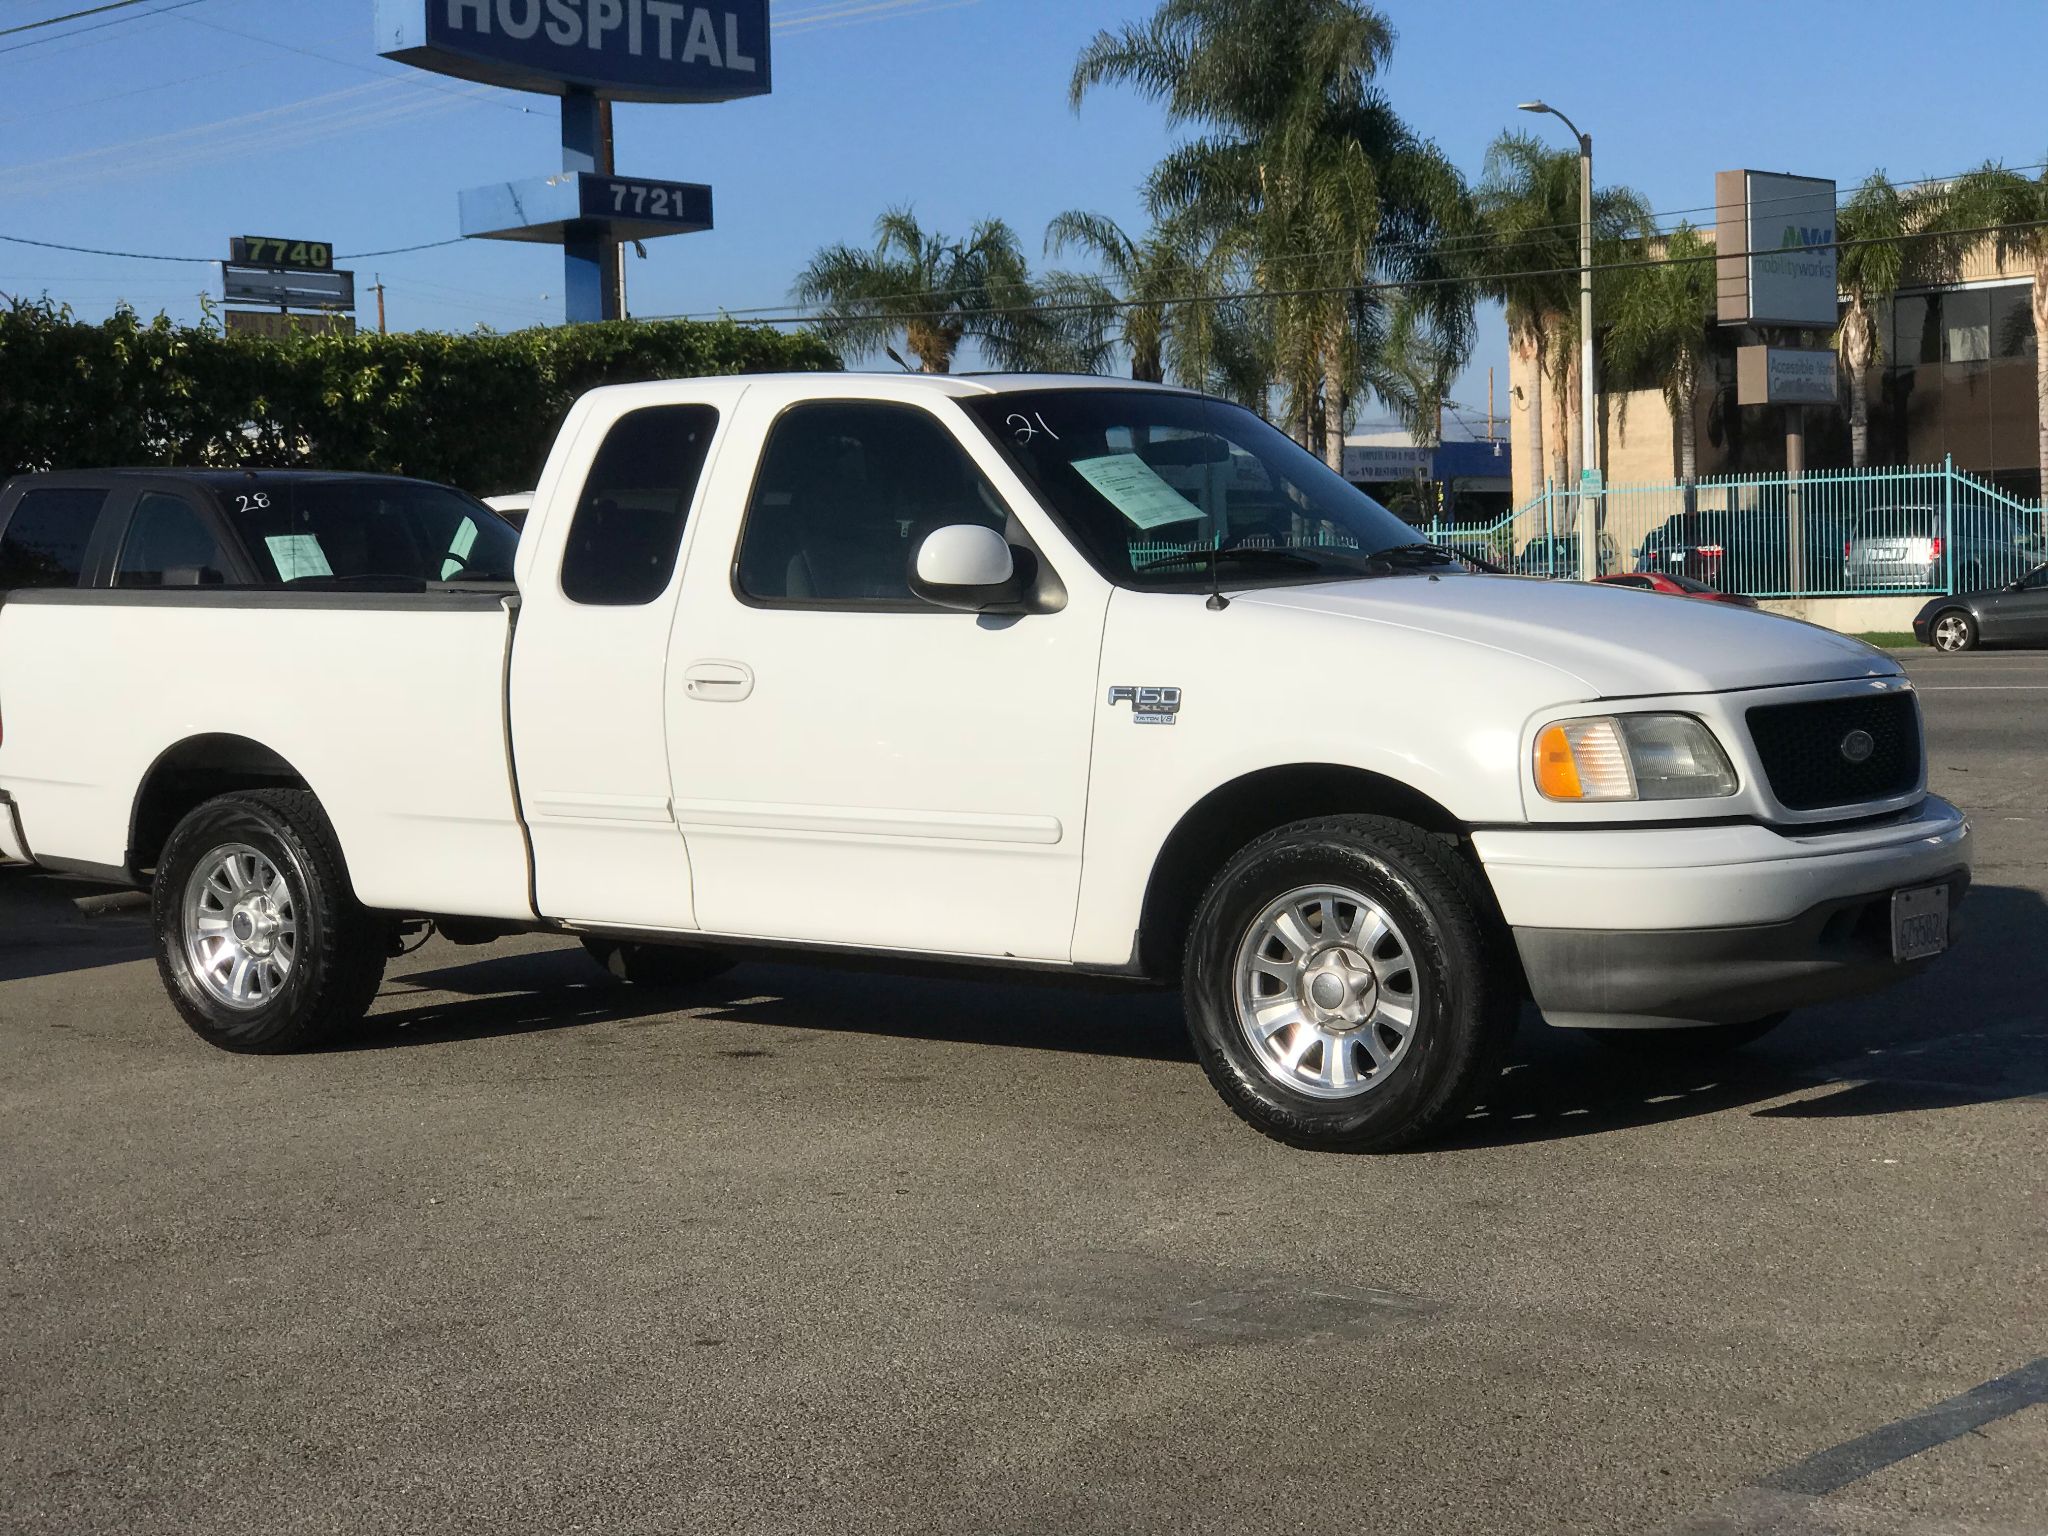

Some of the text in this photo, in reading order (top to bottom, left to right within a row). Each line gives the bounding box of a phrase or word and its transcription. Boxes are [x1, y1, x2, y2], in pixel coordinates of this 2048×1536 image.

[609, 184, 684, 217] 7721
[245, 237, 328, 268] 7740
[1006, 411, 1060, 444] 21
[236, 493, 270, 512] 28
[1161, 714, 1173, 723] V8
